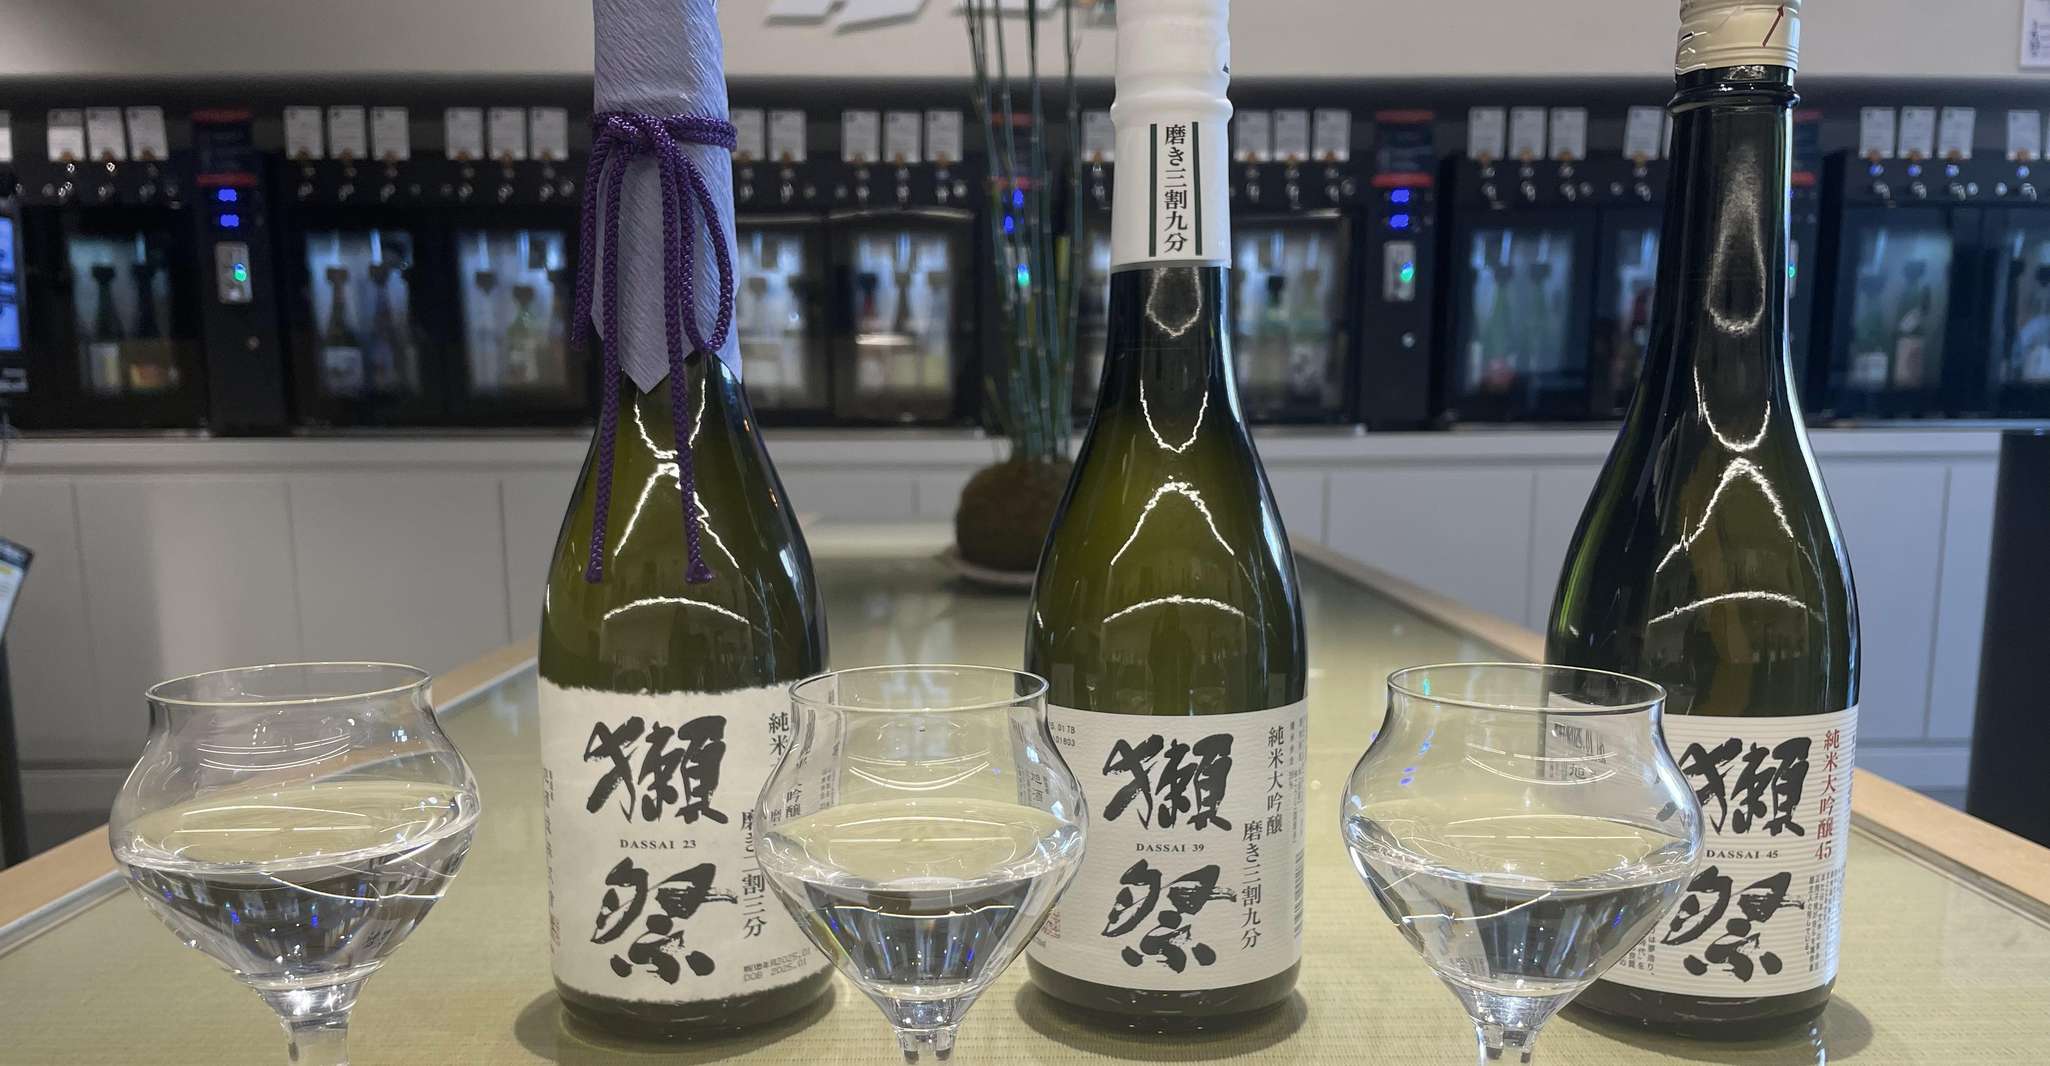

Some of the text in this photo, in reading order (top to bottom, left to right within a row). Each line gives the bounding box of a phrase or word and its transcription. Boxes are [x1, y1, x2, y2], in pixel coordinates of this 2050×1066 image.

[1164, 123, 1188, 254] 磨き三割九分
[1265, 725, 1285, 838] 純米大吟醸
[620, 838, 697, 850] DASSAI 23
[1135, 842, 1205, 853] DASSAI 39
[1706, 848, 1779, 859] DASSAI 45
[1240, 819, 1264, 952] 磨き三割九分
